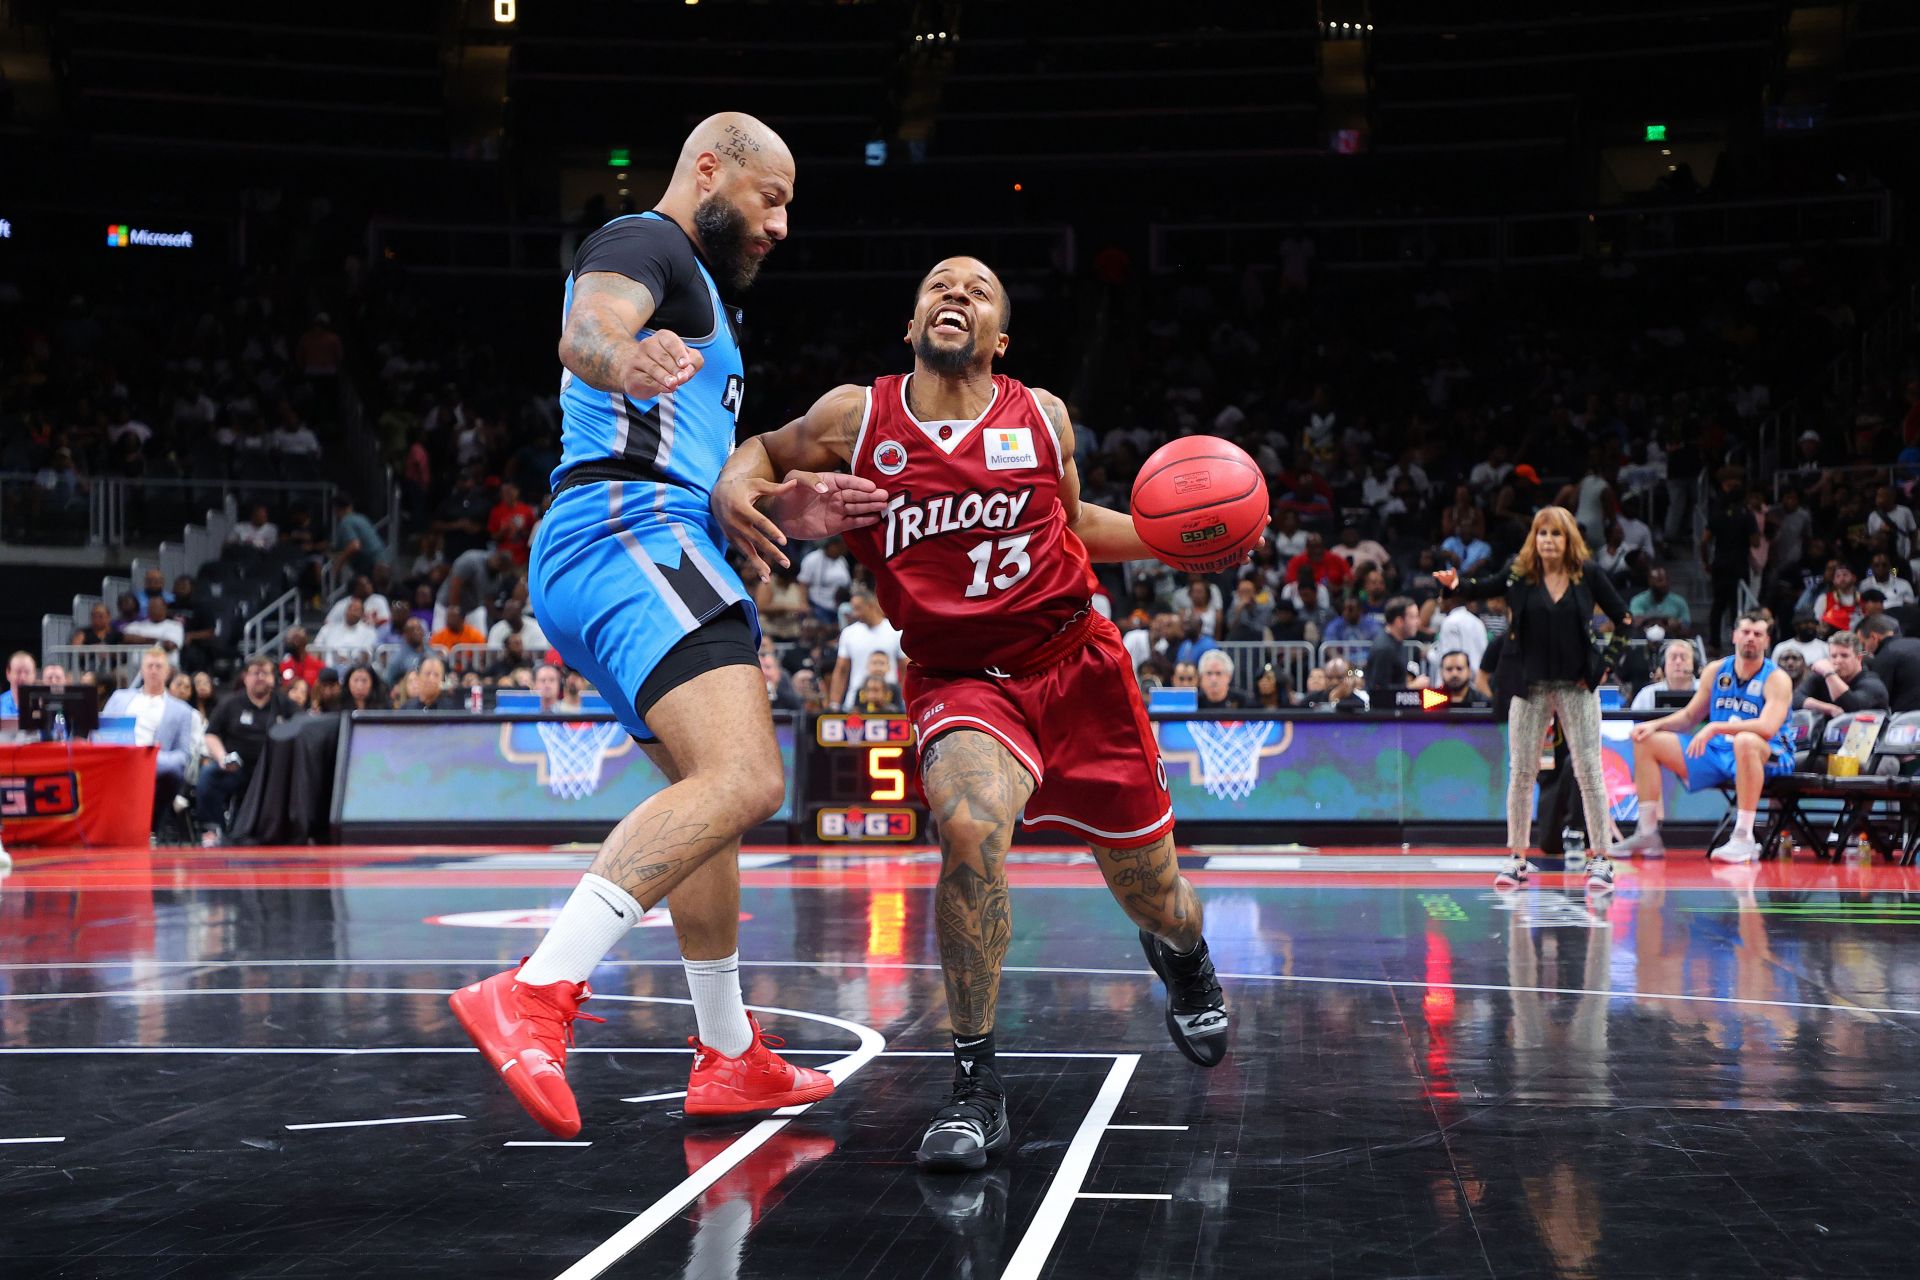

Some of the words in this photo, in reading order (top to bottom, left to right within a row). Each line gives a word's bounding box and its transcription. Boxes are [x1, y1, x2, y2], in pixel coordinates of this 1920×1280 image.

[724, 124, 761, 152] JESUS
[730, 137, 746, 153] IS
[715, 141, 747, 168] KING
[130, 229, 193, 248] Microsoft
[991, 452, 1032, 464] Microsoft
[881, 490, 1032, 559] TRILOGY
[964, 533, 1033, 598] 13
[868, 747, 905, 801] 5
